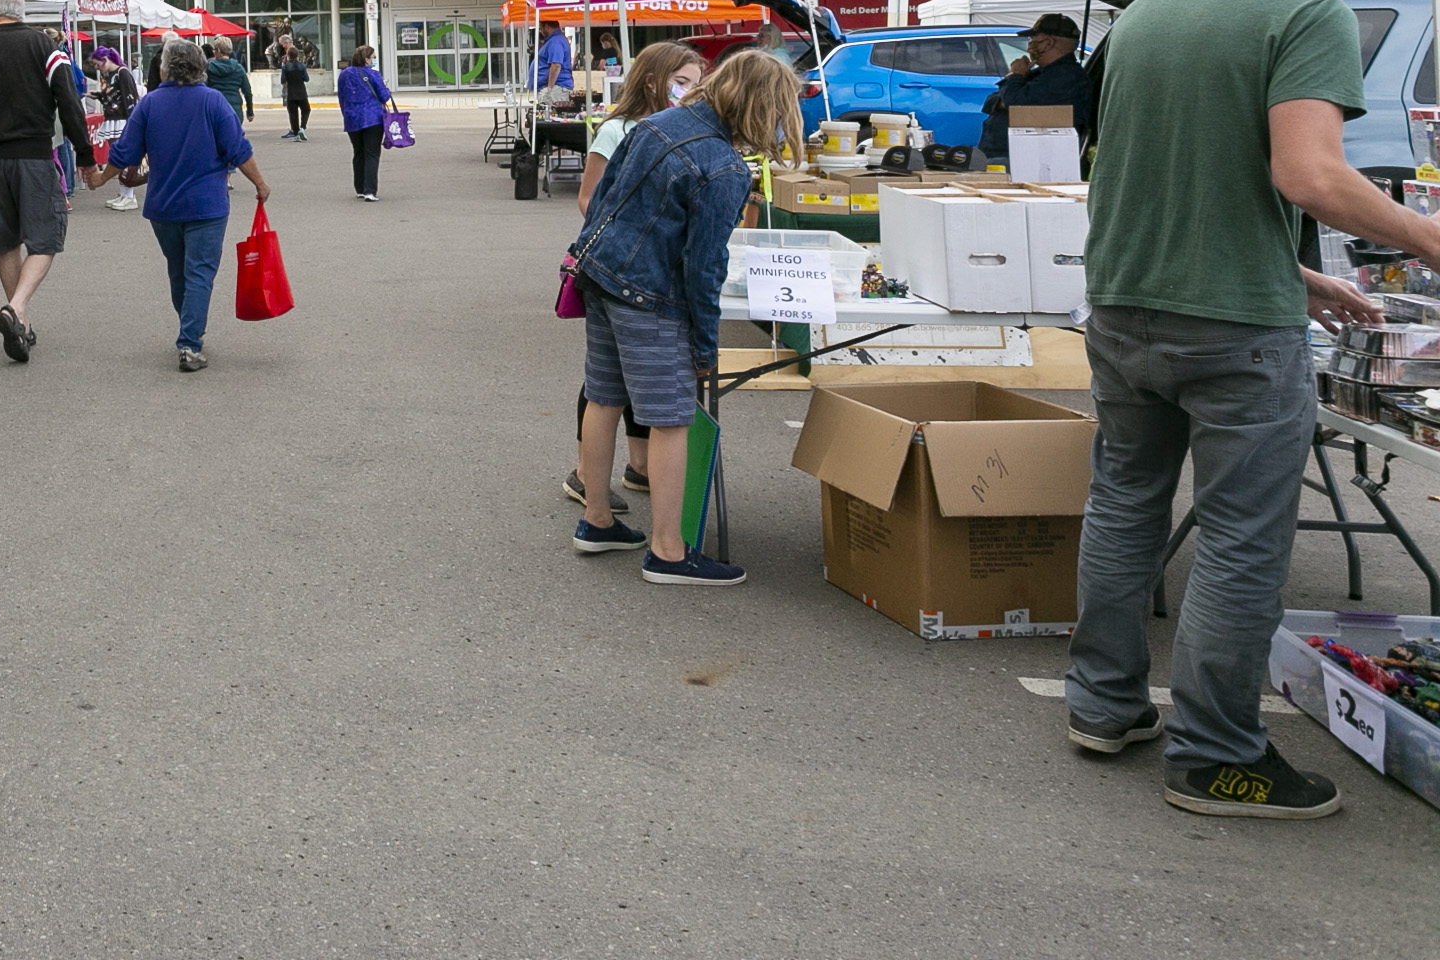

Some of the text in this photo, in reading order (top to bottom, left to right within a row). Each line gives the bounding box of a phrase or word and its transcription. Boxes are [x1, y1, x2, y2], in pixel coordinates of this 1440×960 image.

[640, 0, 673, 11] FOR
[678, 0, 709, 12] YOU
[840, 7, 857, 15] Red
[858, 6, 880, 14] Deer
[772, 254, 802, 264] LEGO
[749, 267, 827, 280] MINIFIGURES
[771, 309, 813, 320] 2 FOR $5
[836, 323, 853, 331] 403
[856, 323, 872, 331] 865
